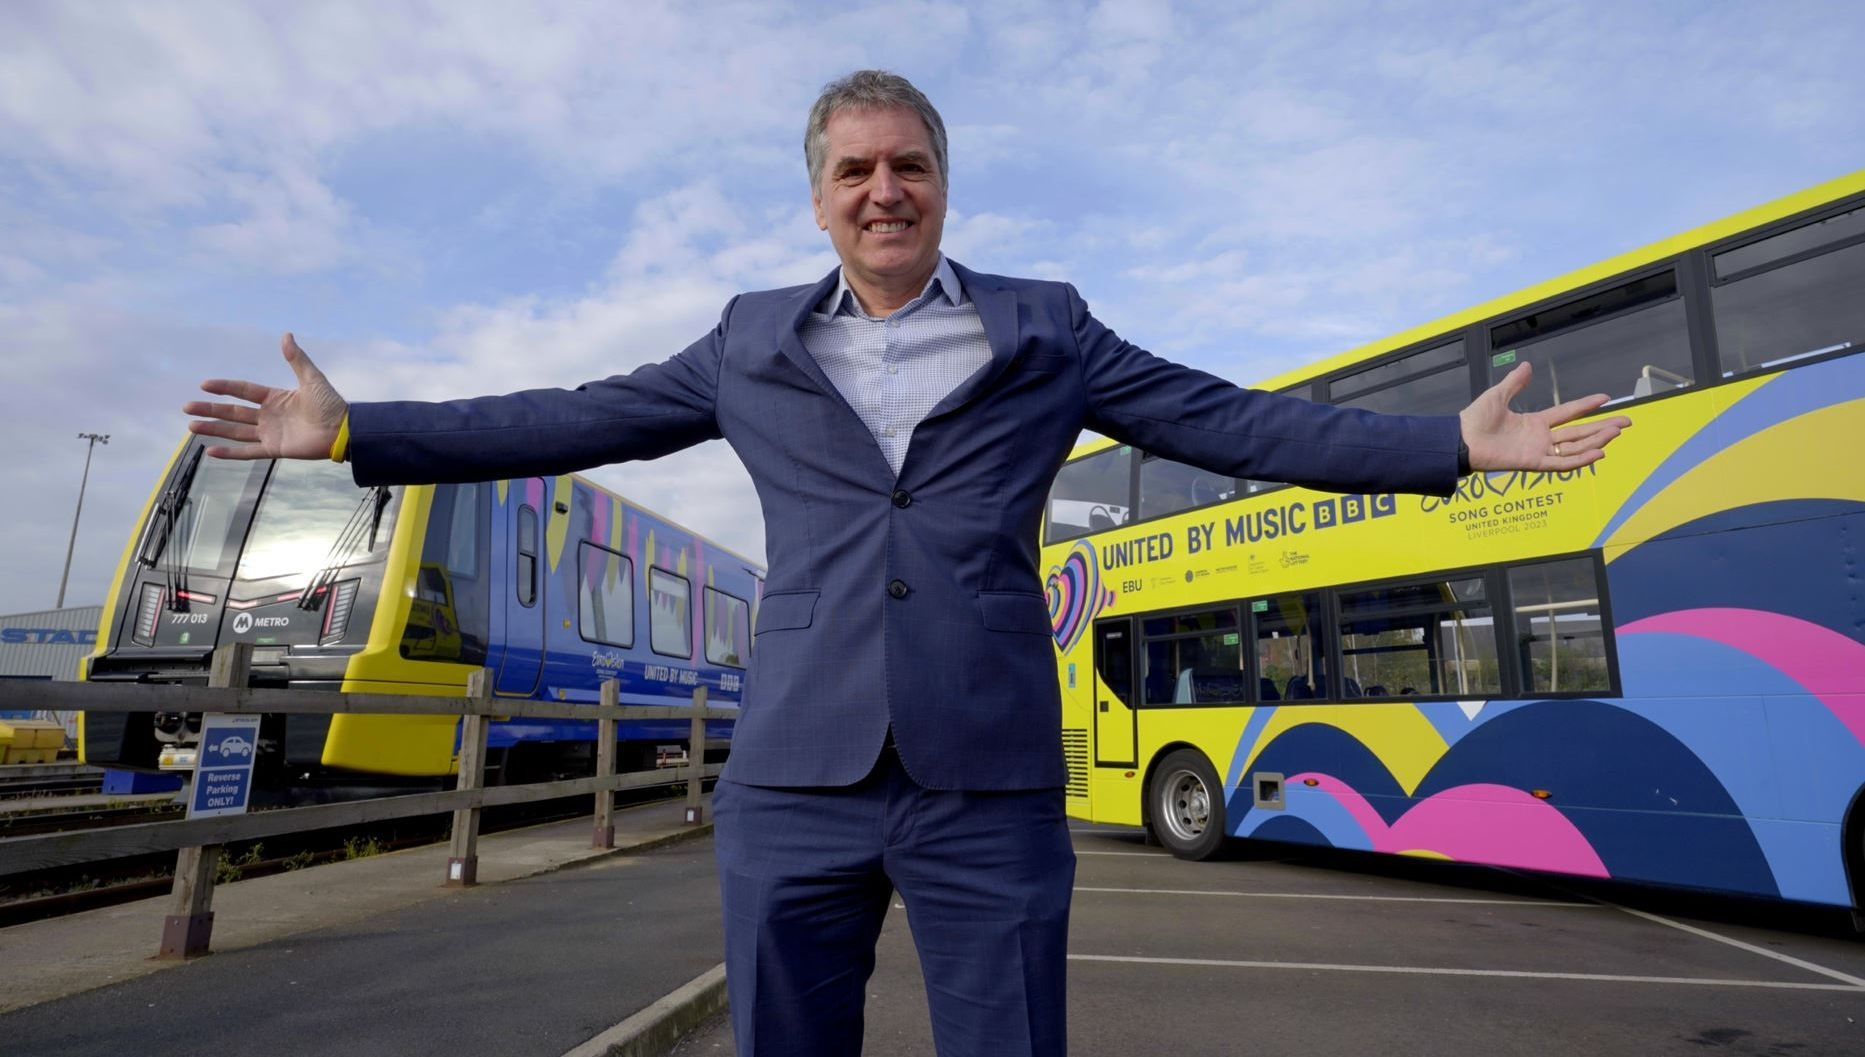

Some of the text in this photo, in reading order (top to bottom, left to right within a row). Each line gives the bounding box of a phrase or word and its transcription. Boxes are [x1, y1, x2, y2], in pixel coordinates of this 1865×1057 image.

[1449, 492, 1564, 524] SONG CONTEST
[1465, 510, 1548, 532] UNITED KINGDOM
[1103, 494, 1396, 571] UNITED BY MUSIC BBC
[1467, 520, 1548, 540] LIVERPOOL 2023
[1122, 578, 1142, 594] EBU
[171, 613, 208, 625] 777 013
[254, 617, 289, 627] METRO
[644, 664, 669, 682] UNITED
[669, 668, 679, 683] BY
[679, 670, 699, 686] MUSIC
[207, 773, 241, 783] Reverse
[206, 785, 239, 795] Parking
[207, 797, 234, 808] ONLY!
